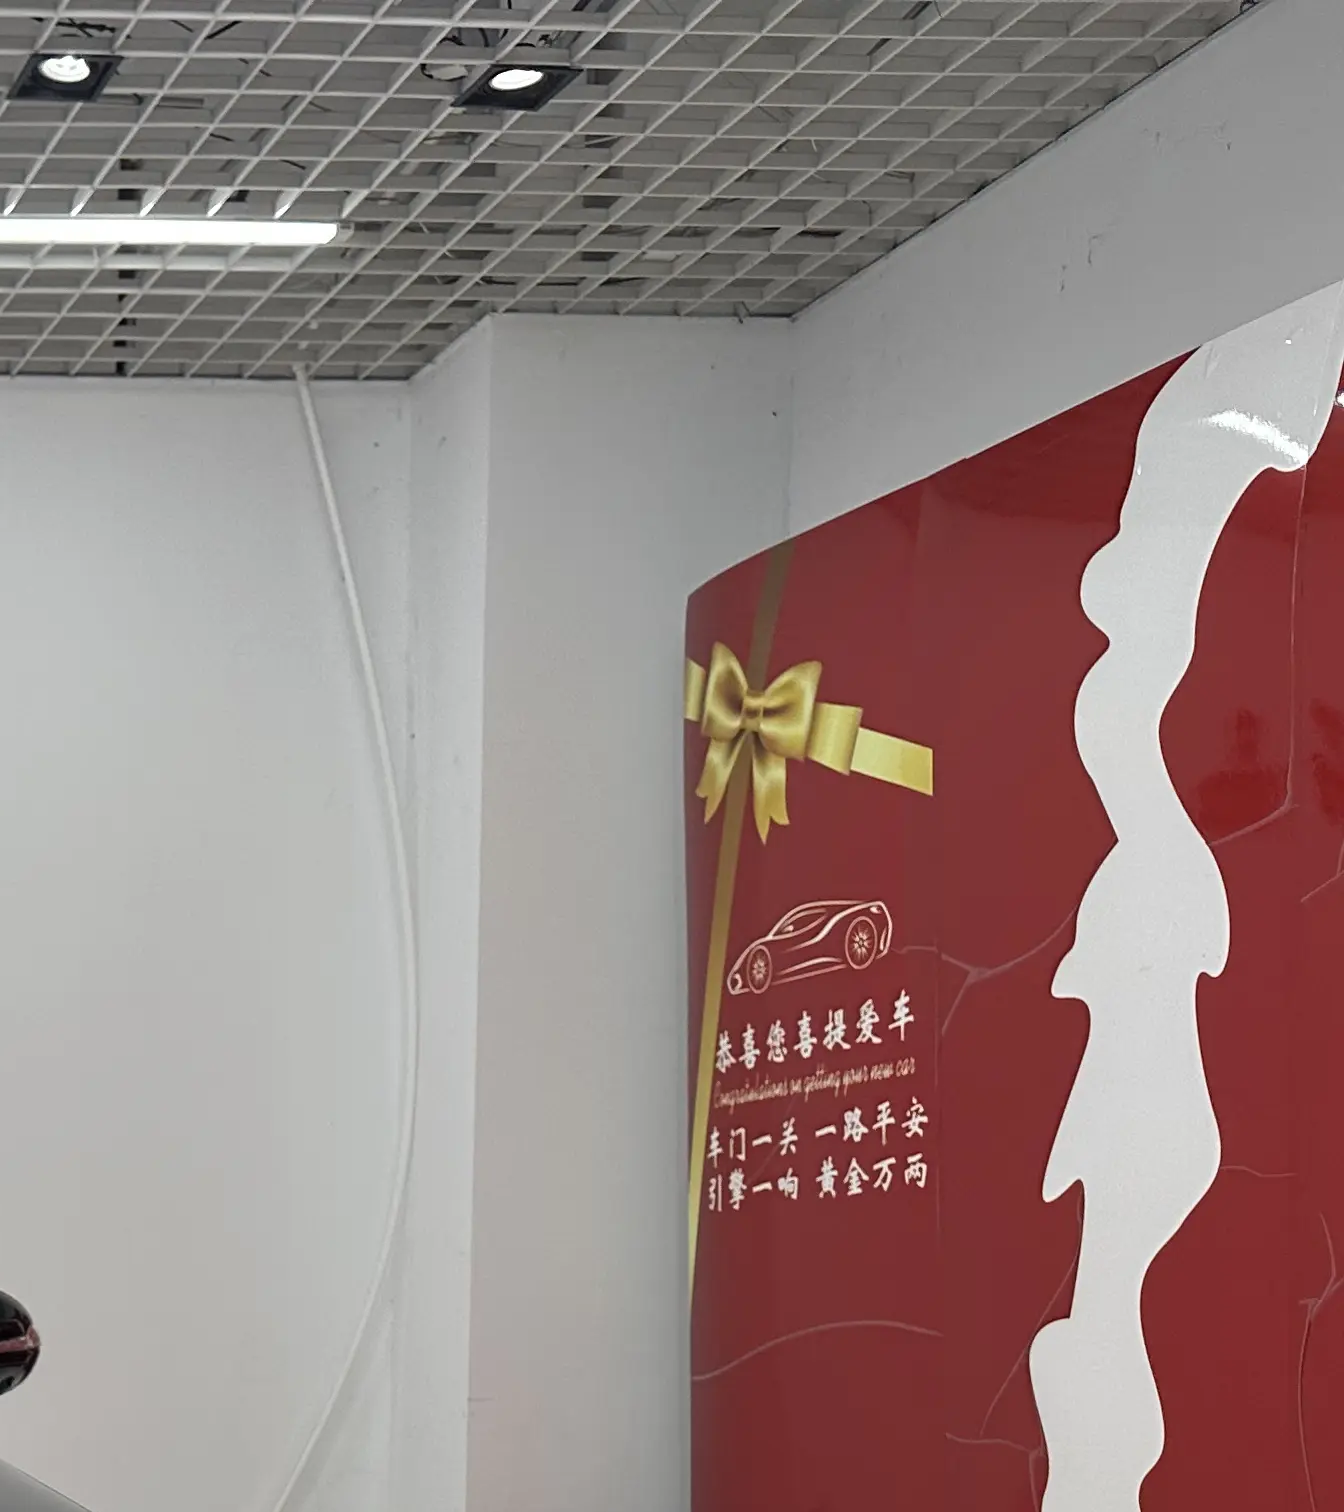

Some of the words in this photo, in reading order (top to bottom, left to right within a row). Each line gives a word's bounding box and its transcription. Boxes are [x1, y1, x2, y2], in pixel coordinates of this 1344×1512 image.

[715, 988, 915, 1074] 恭喜您喜提爱车
[707, 1116, 799, 1169] 车门一关
[815, 1096, 929, 1147] 一路平安
[708, 1167, 800, 1213] 引擎一响
[815, 1152, 928, 1199] 黄金万两
